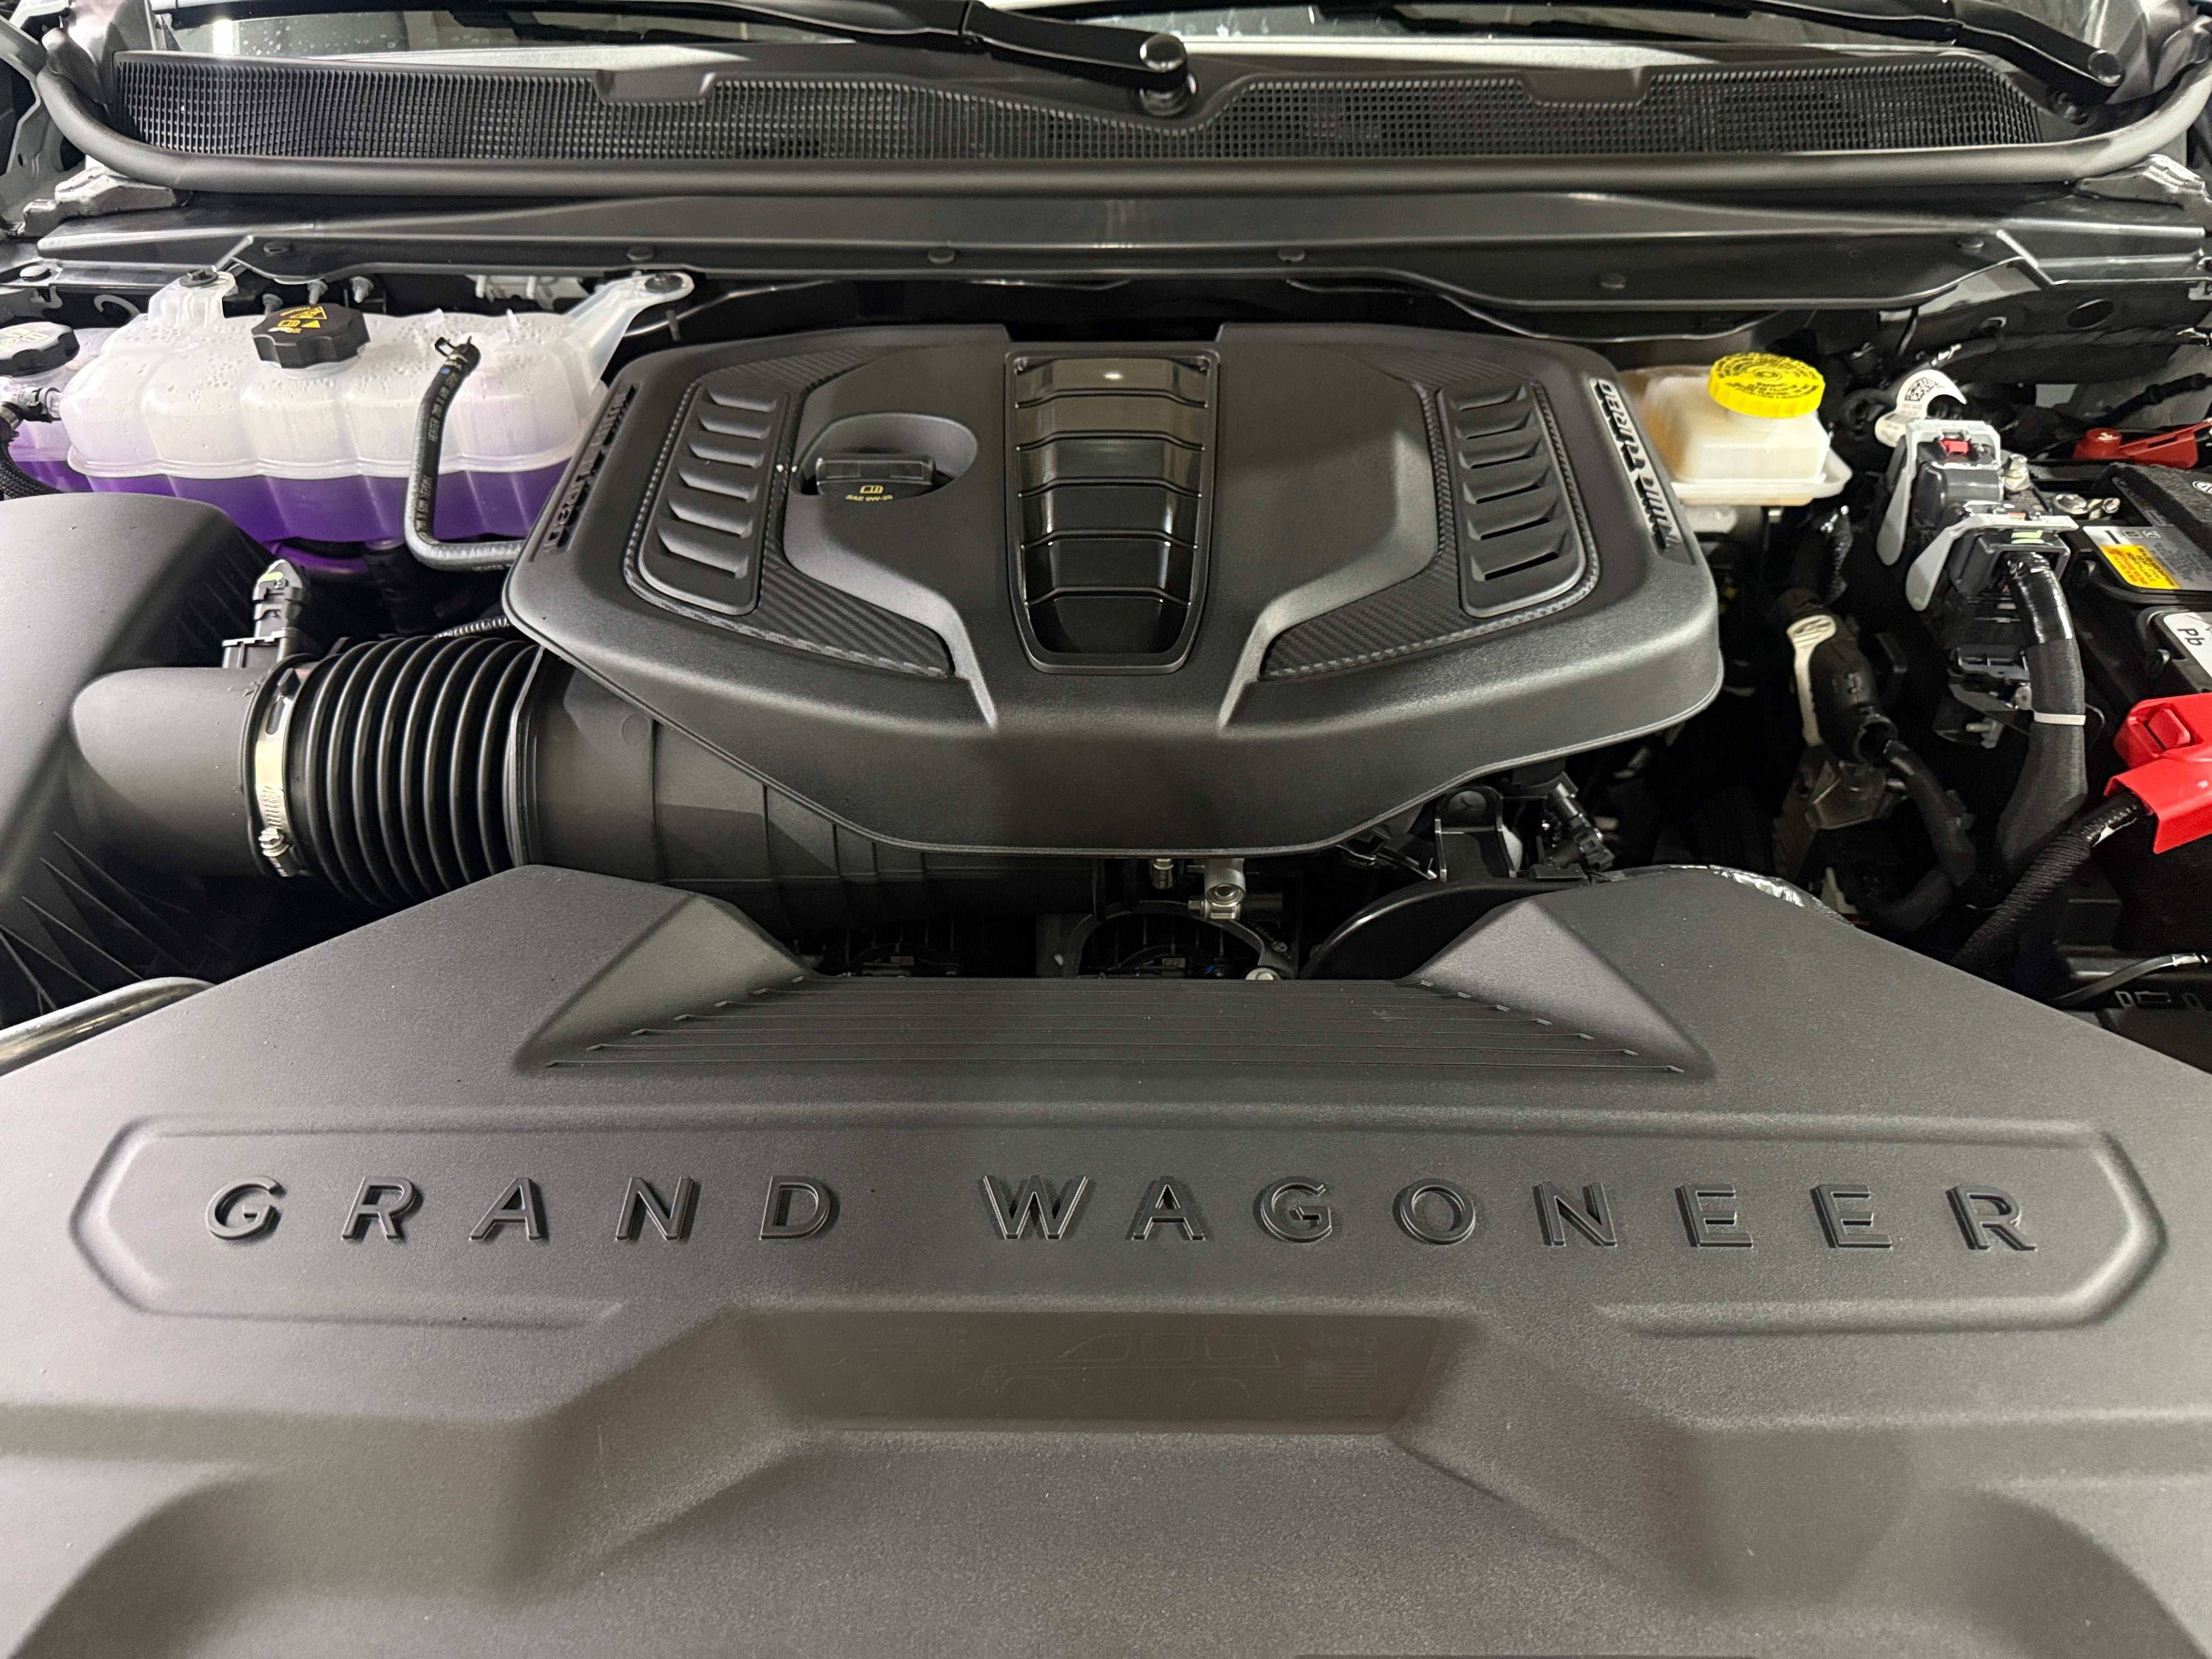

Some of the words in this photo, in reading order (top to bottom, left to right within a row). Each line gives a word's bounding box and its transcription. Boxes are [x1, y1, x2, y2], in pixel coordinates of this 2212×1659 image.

[1594, 379, 1646, 472] TURBO
[2177, 628, 2205, 646] Pb
[205, 1175, 833, 1241] GRAND
[981, 1174, 2038, 1252] WAGONEER
[1308, 1331, 1378, 1355] Jeep
